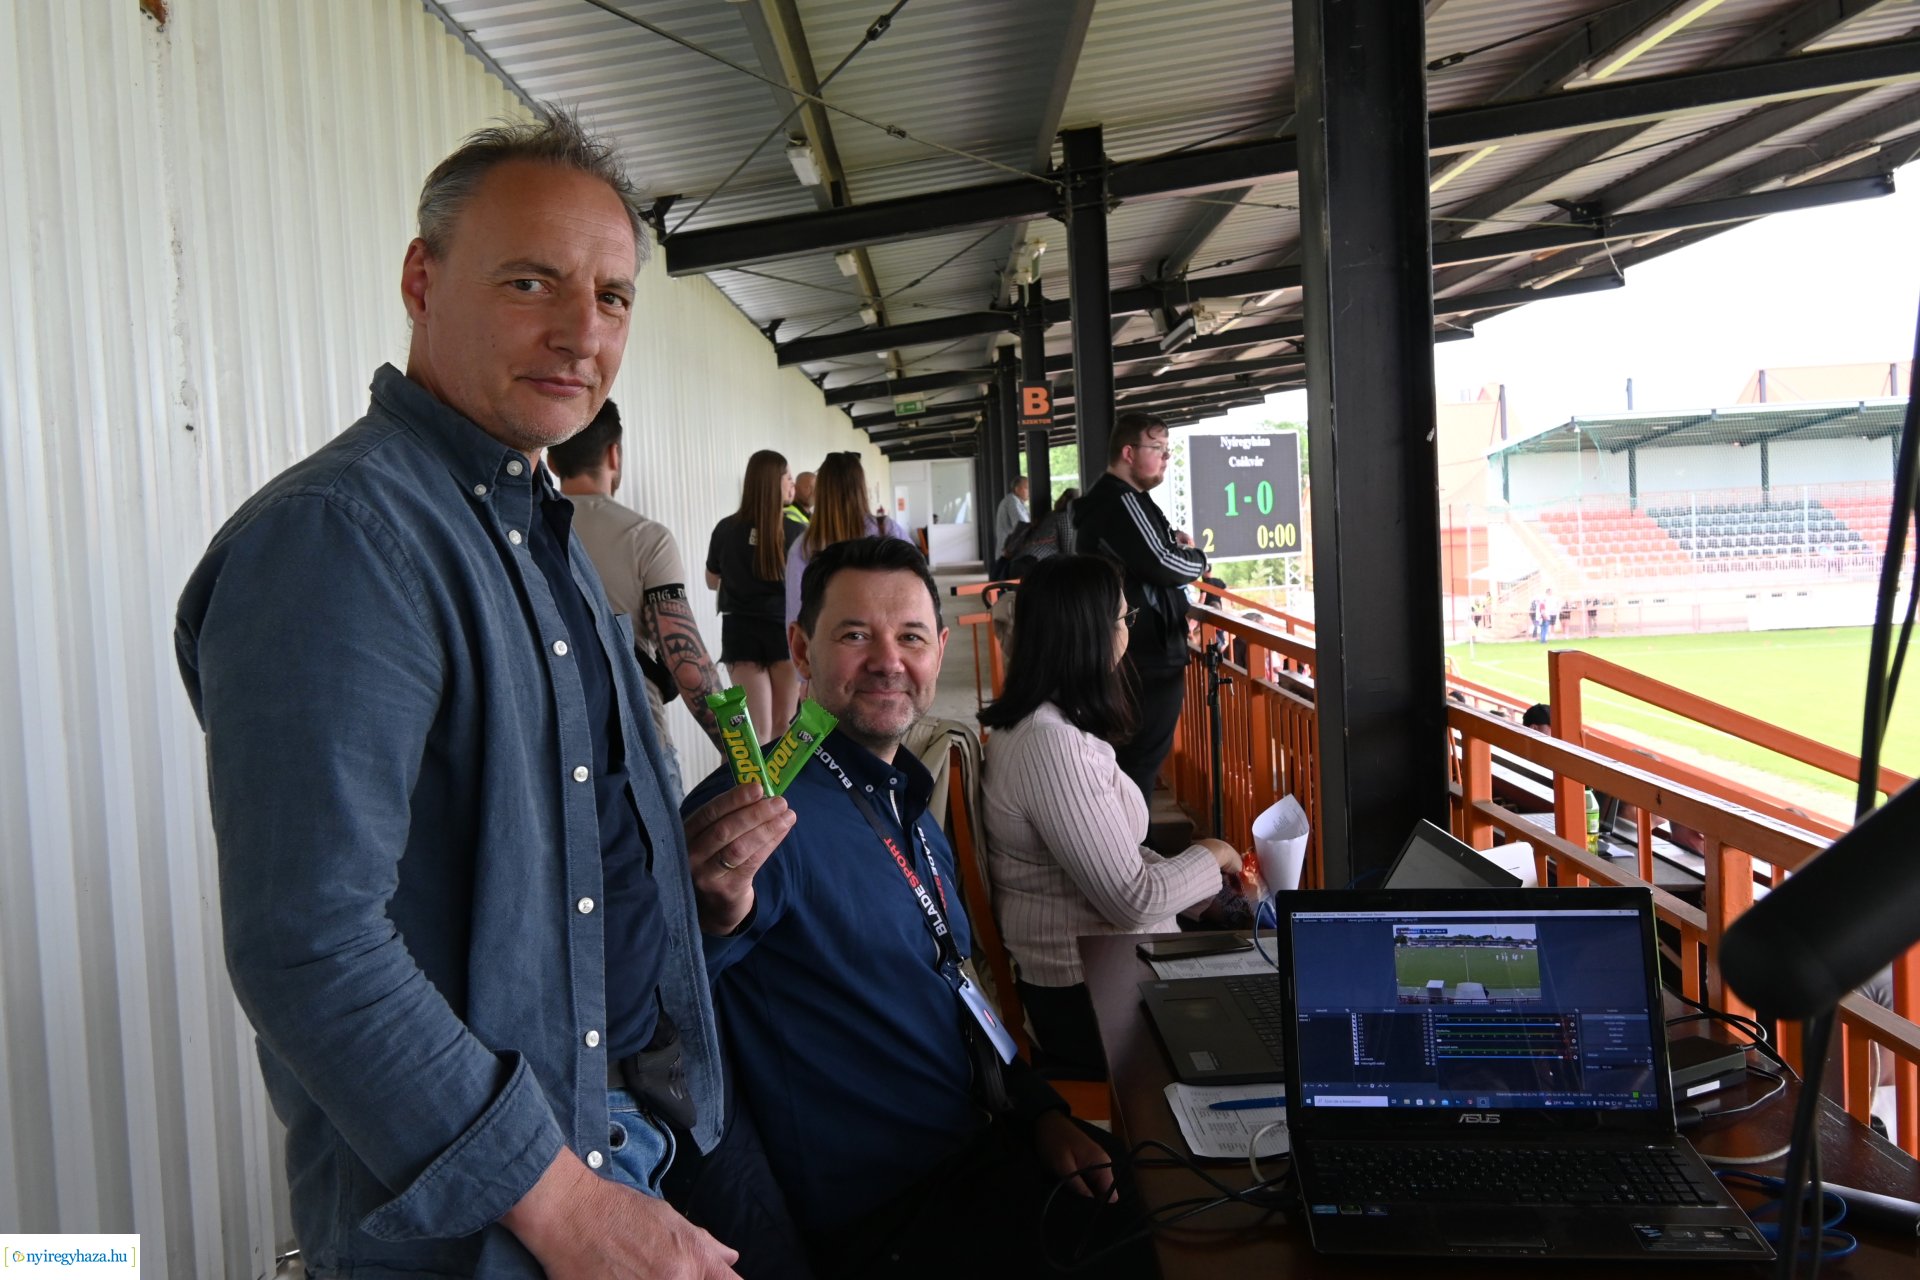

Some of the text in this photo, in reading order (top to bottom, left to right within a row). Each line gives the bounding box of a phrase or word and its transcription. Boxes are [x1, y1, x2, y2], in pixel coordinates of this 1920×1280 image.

[1023, 387, 1050, 416] B
[1202, 523, 1296, 552] 2 0:00
[766, 730, 799, 785] port
[1458, 1113, 1501, 1124] ASUS
